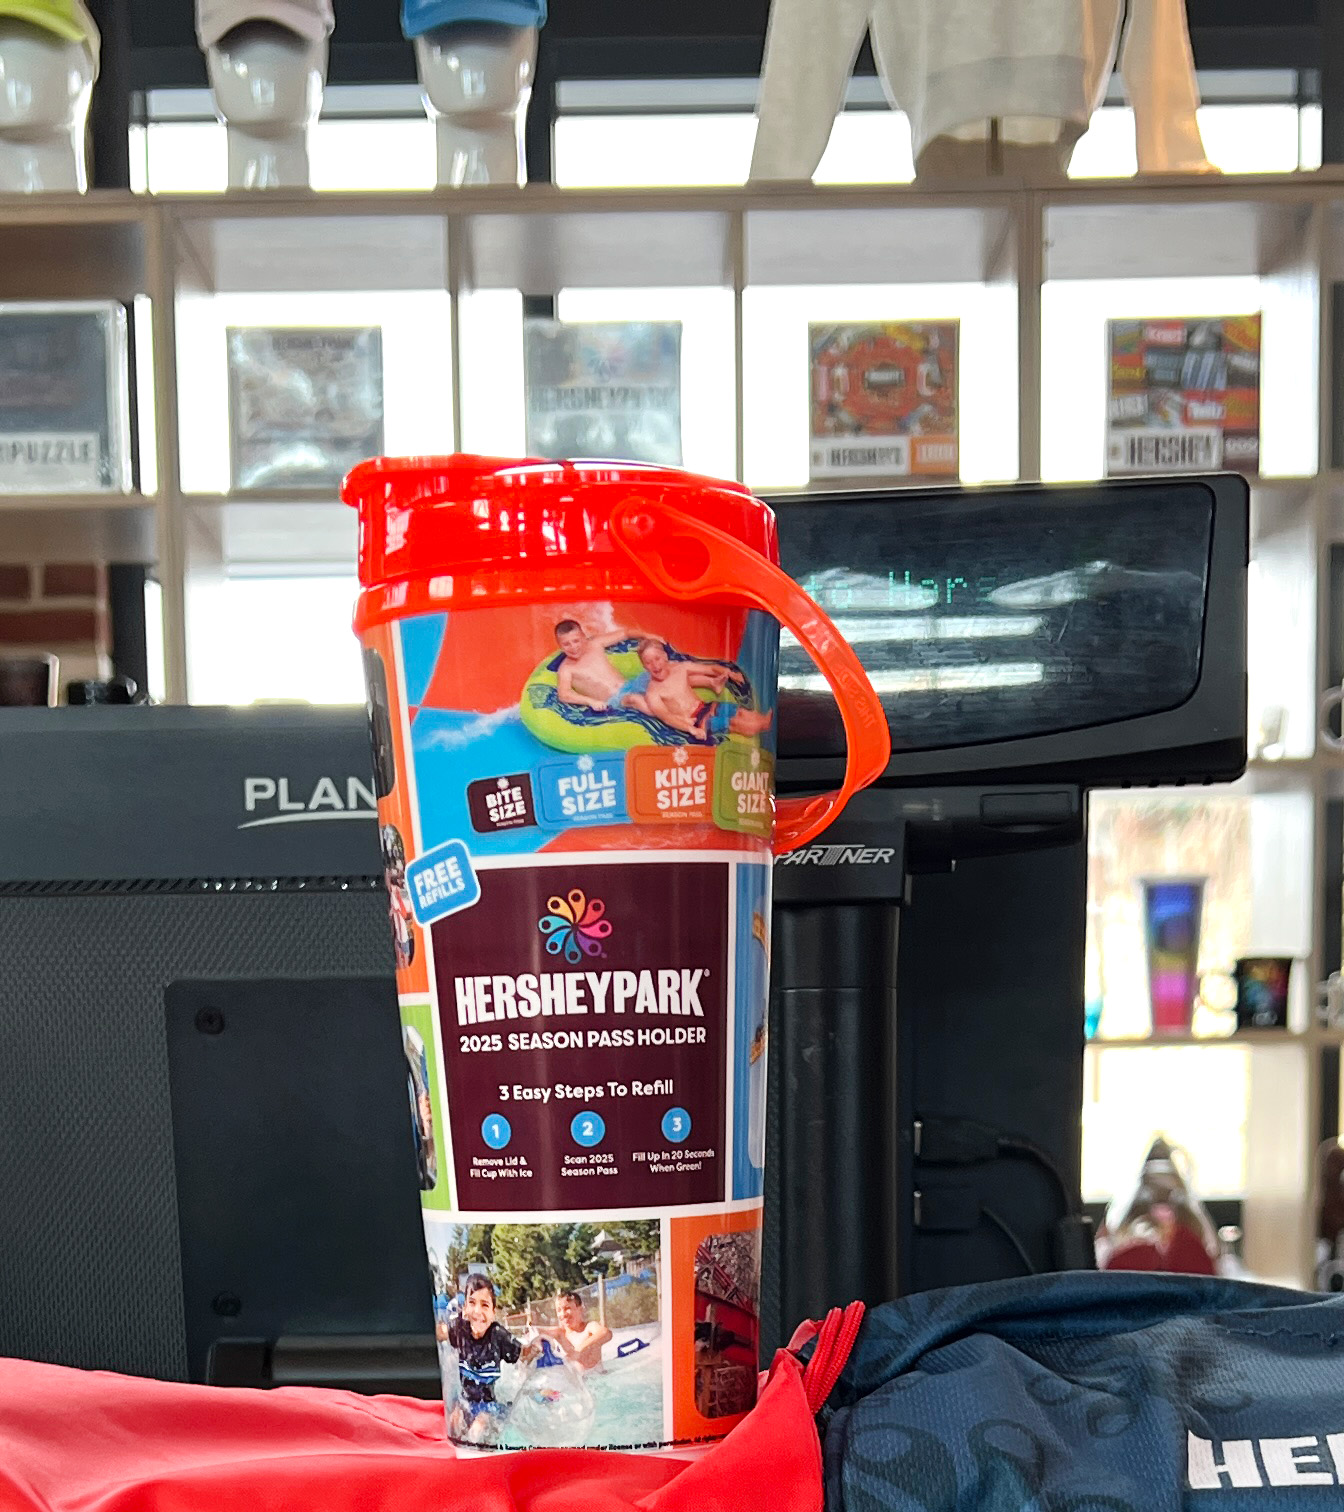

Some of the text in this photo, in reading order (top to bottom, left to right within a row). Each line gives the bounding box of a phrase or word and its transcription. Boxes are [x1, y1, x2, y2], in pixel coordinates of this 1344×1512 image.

[558, 768, 616, 797] FULL
[654, 764, 707, 789] KING
[731, 771, 770, 793] GIANT
[485, 786, 523, 808] BITE
[561, 789, 617, 816] SIZE
[655, 785, 706, 811] SIZE
[736, 793, 767, 814] SIZE
[488, 803, 527, 823] SIZE
[413, 856, 462, 895] FREE
[418, 877, 466, 909] REFILLS
[454, 967, 705, 1027] HERSHEYPARK
[459, 1026, 706, 1053] 2025 SEASON PASS HOLDER
[498, 1079, 674, 1103] 3 Easy Steps To Refill
[472, 1156, 504, 1167] Remove
[505, 1155, 518, 1166] Lid
[564, 1153, 614, 1165] Scan 2025
[684, 1148, 715, 1160] Seconds
[481, 1168, 498, 1180] Cup
[498, 1167, 518, 1178] With
[519, 1168, 533, 1178] Ice
[561, 1165, 619, 1177] Season Pass
[649, 1163, 675, 1174] When
